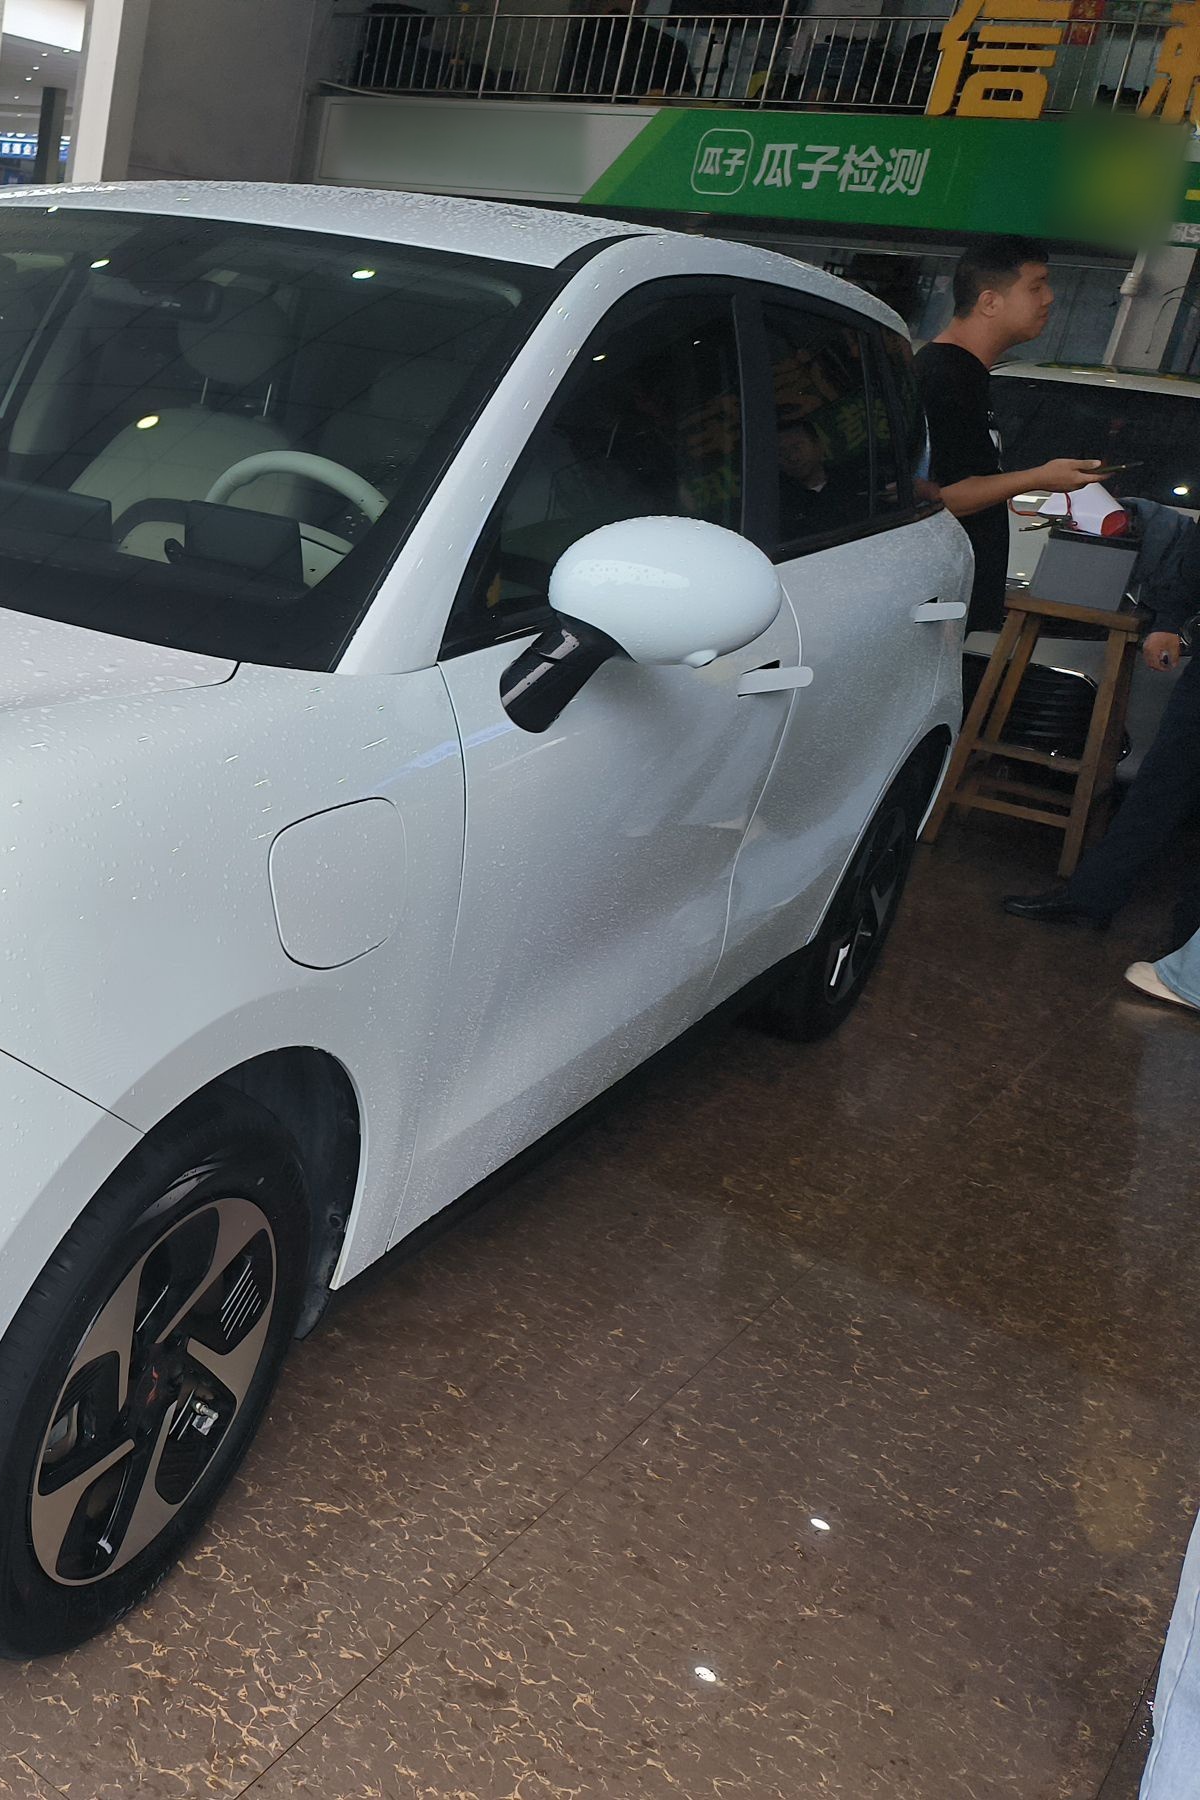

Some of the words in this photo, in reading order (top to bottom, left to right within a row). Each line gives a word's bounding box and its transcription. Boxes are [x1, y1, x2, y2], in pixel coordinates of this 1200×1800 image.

[698, 147, 746, 177] 瓜子
[752, 143, 931, 196] 瓜子检测
